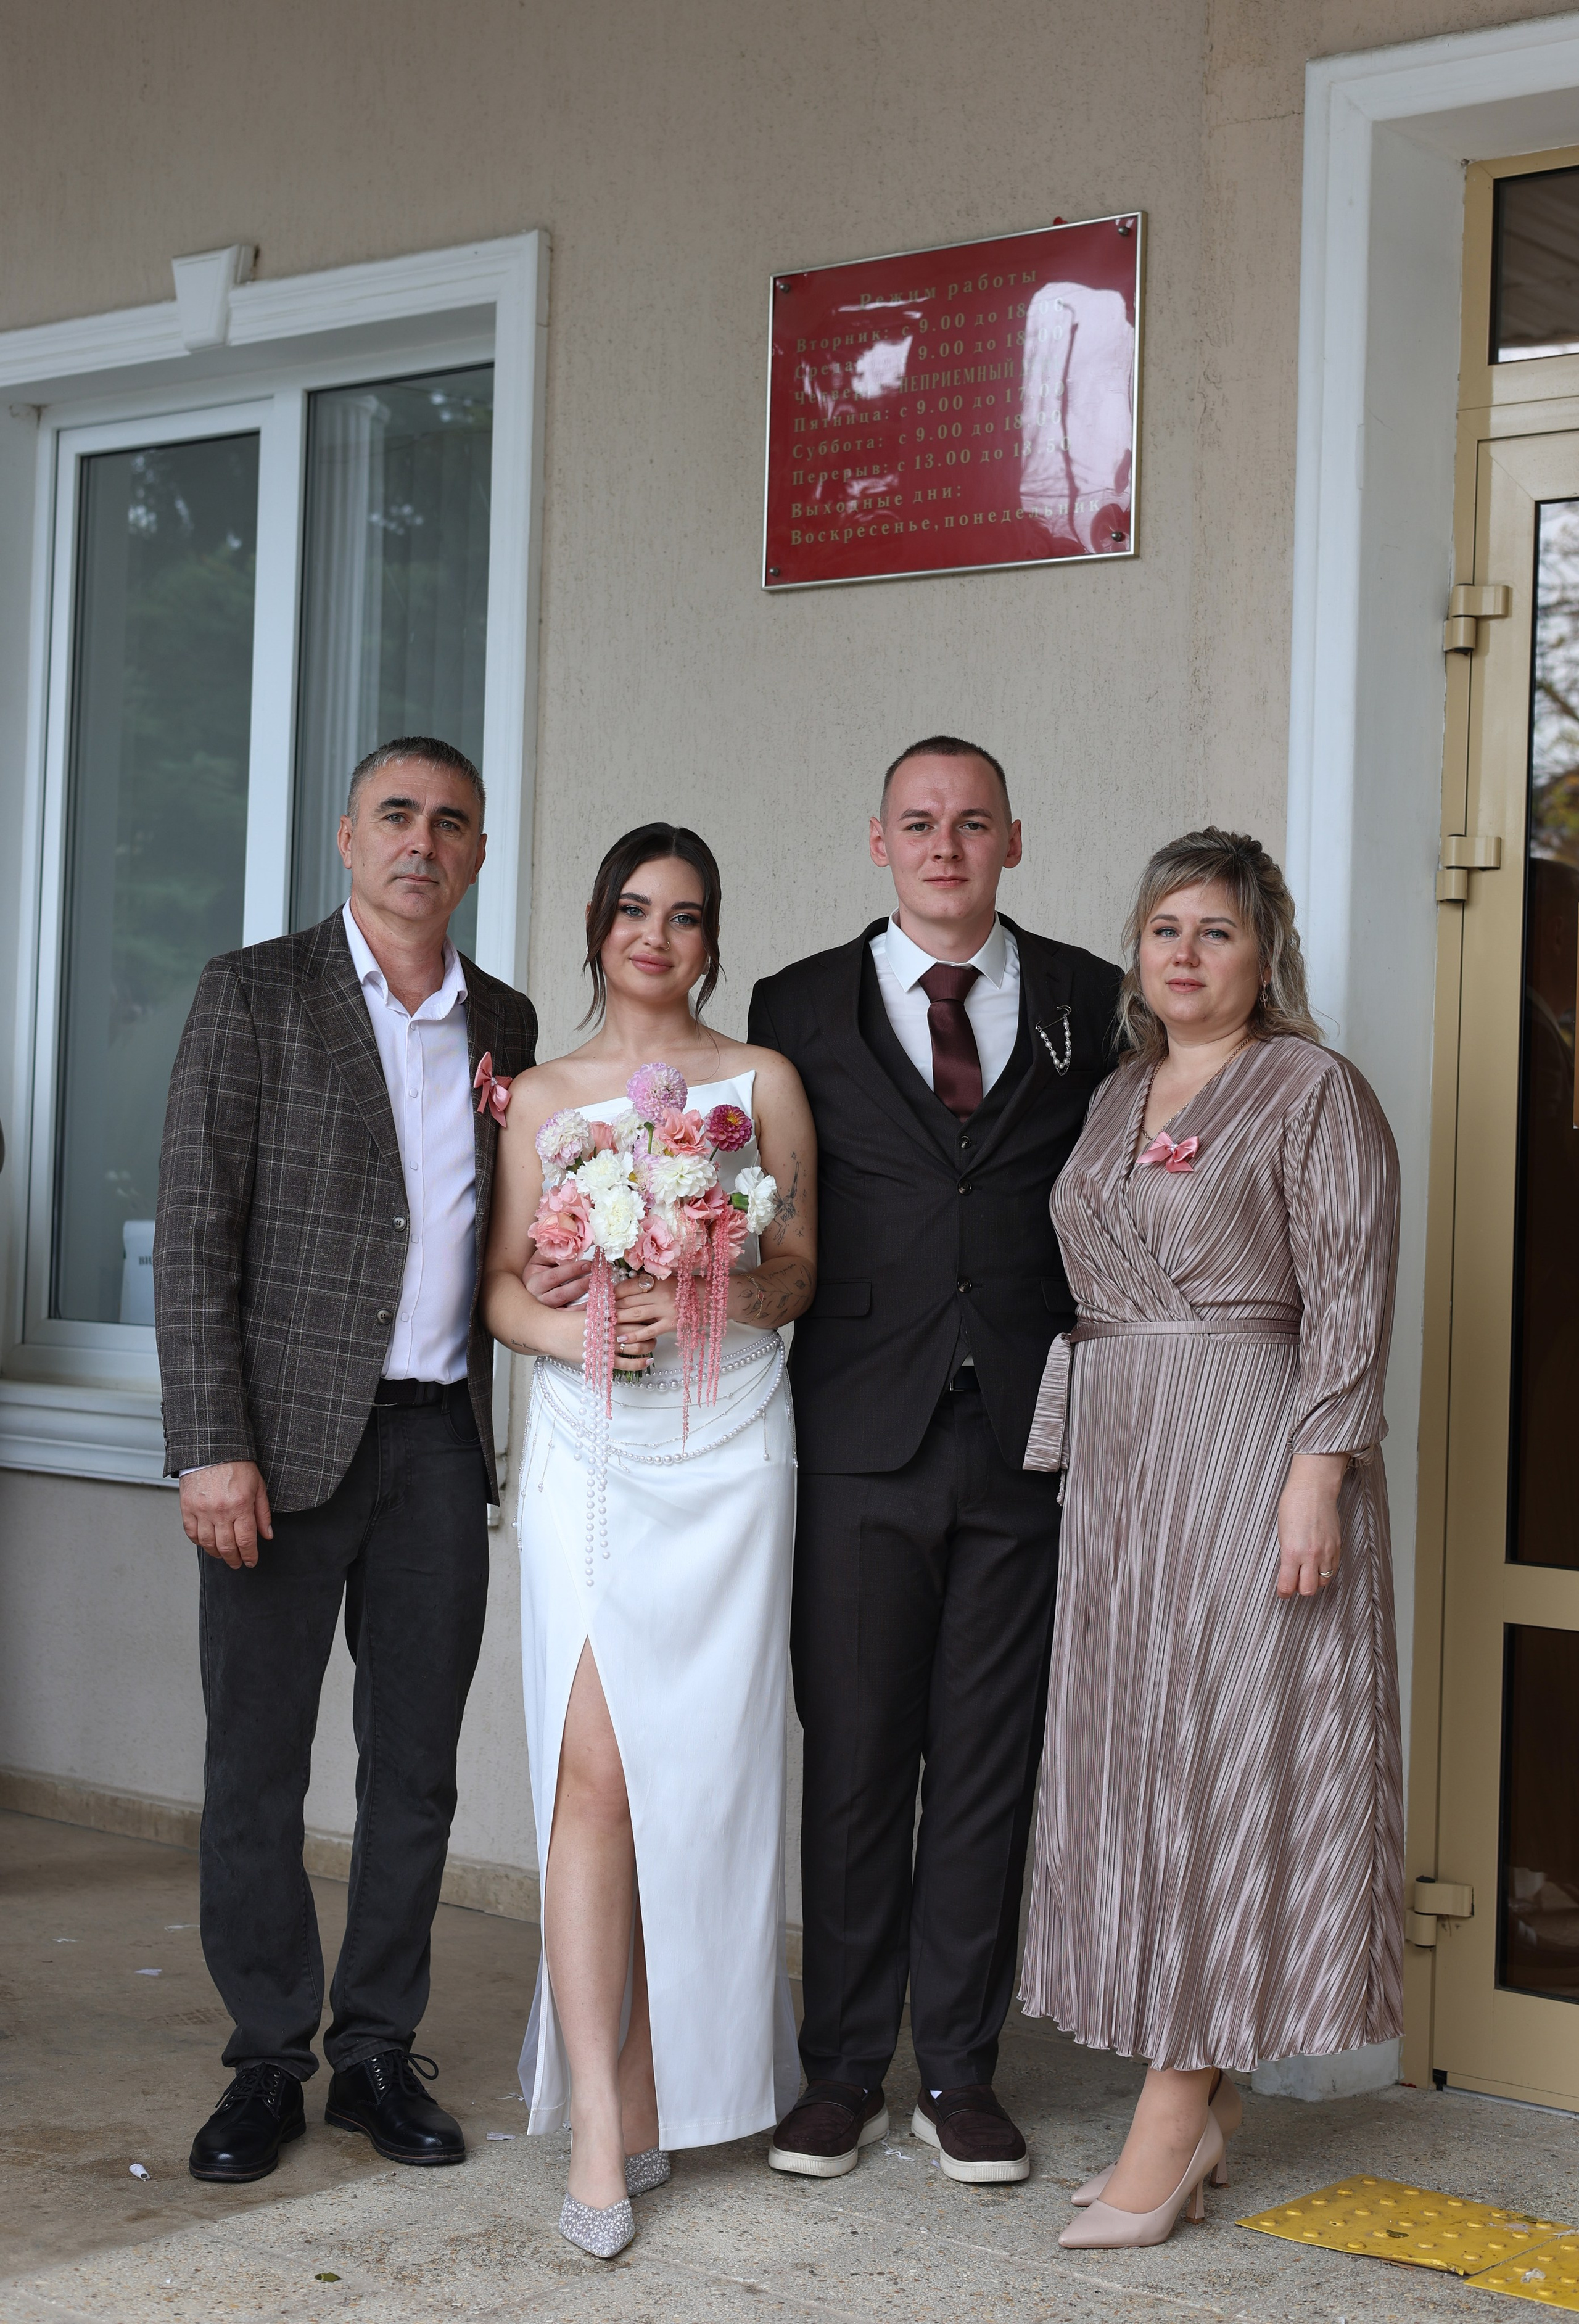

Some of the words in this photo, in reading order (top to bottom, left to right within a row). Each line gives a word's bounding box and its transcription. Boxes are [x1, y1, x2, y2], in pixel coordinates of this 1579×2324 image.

[860, 287, 936, 310] Режим
[947, 270, 1036, 300] работы
[796, 329, 889, 353] Вторник:
[902, 326, 910, 336] с
[919, 313, 965, 334] 9.00
[974, 312, 997, 327] до
[795, 360, 861, 381] Среда
[918, 340, 964, 360] 9.00
[973, 340, 996, 354] до
[899, 358, 1014, 394] НЕПРИЕМНЫЙ
[794, 410, 889, 432] Пятница:
[899, 406, 907, 418] с
[917, 395, 963, 414] 9.00
[972, 395, 995, 408] до
[1006, 381, 1065, 403] 17.00
[793, 437, 883, 461] Суббота:
[899, 434, 906, 445] с
[916, 422, 962, 442] 9.00
[971, 423, 994, 437] до
[1005, 410, 1062, 431] 18.00
[792, 464, 888, 485] Перерыв:
[897, 461, 905, 472] с
[915, 449, 971, 469] 13.00
[980, 449, 1003, 463] до
[1013, 436, 1071, 457] 13.50
[791, 495, 902, 518] Выходные
[913, 486, 961, 503] дни:
